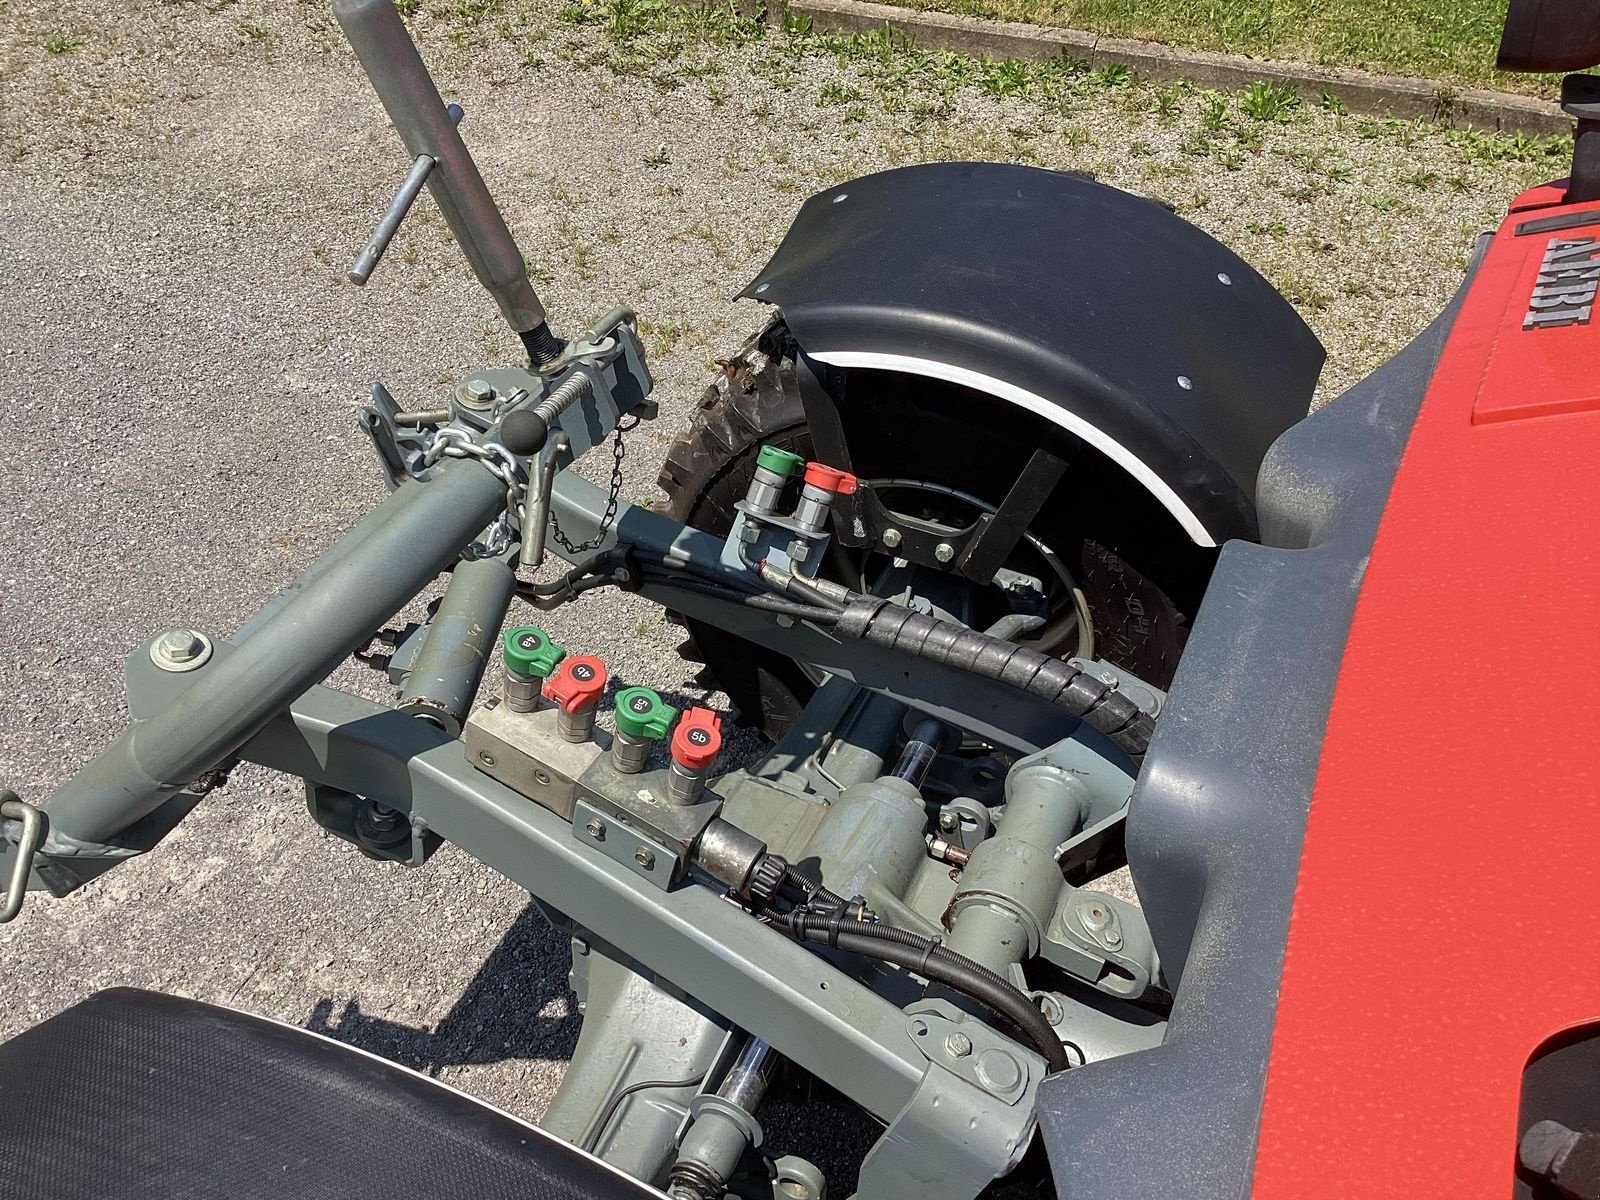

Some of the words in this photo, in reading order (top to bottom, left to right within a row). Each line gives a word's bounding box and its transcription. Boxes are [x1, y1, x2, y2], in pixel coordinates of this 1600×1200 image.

[521, 636, 536, 648] 4a
[577, 666, 591, 678] 4b
[633, 698, 648, 711] 5a
[690, 731, 707, 743] 5b
